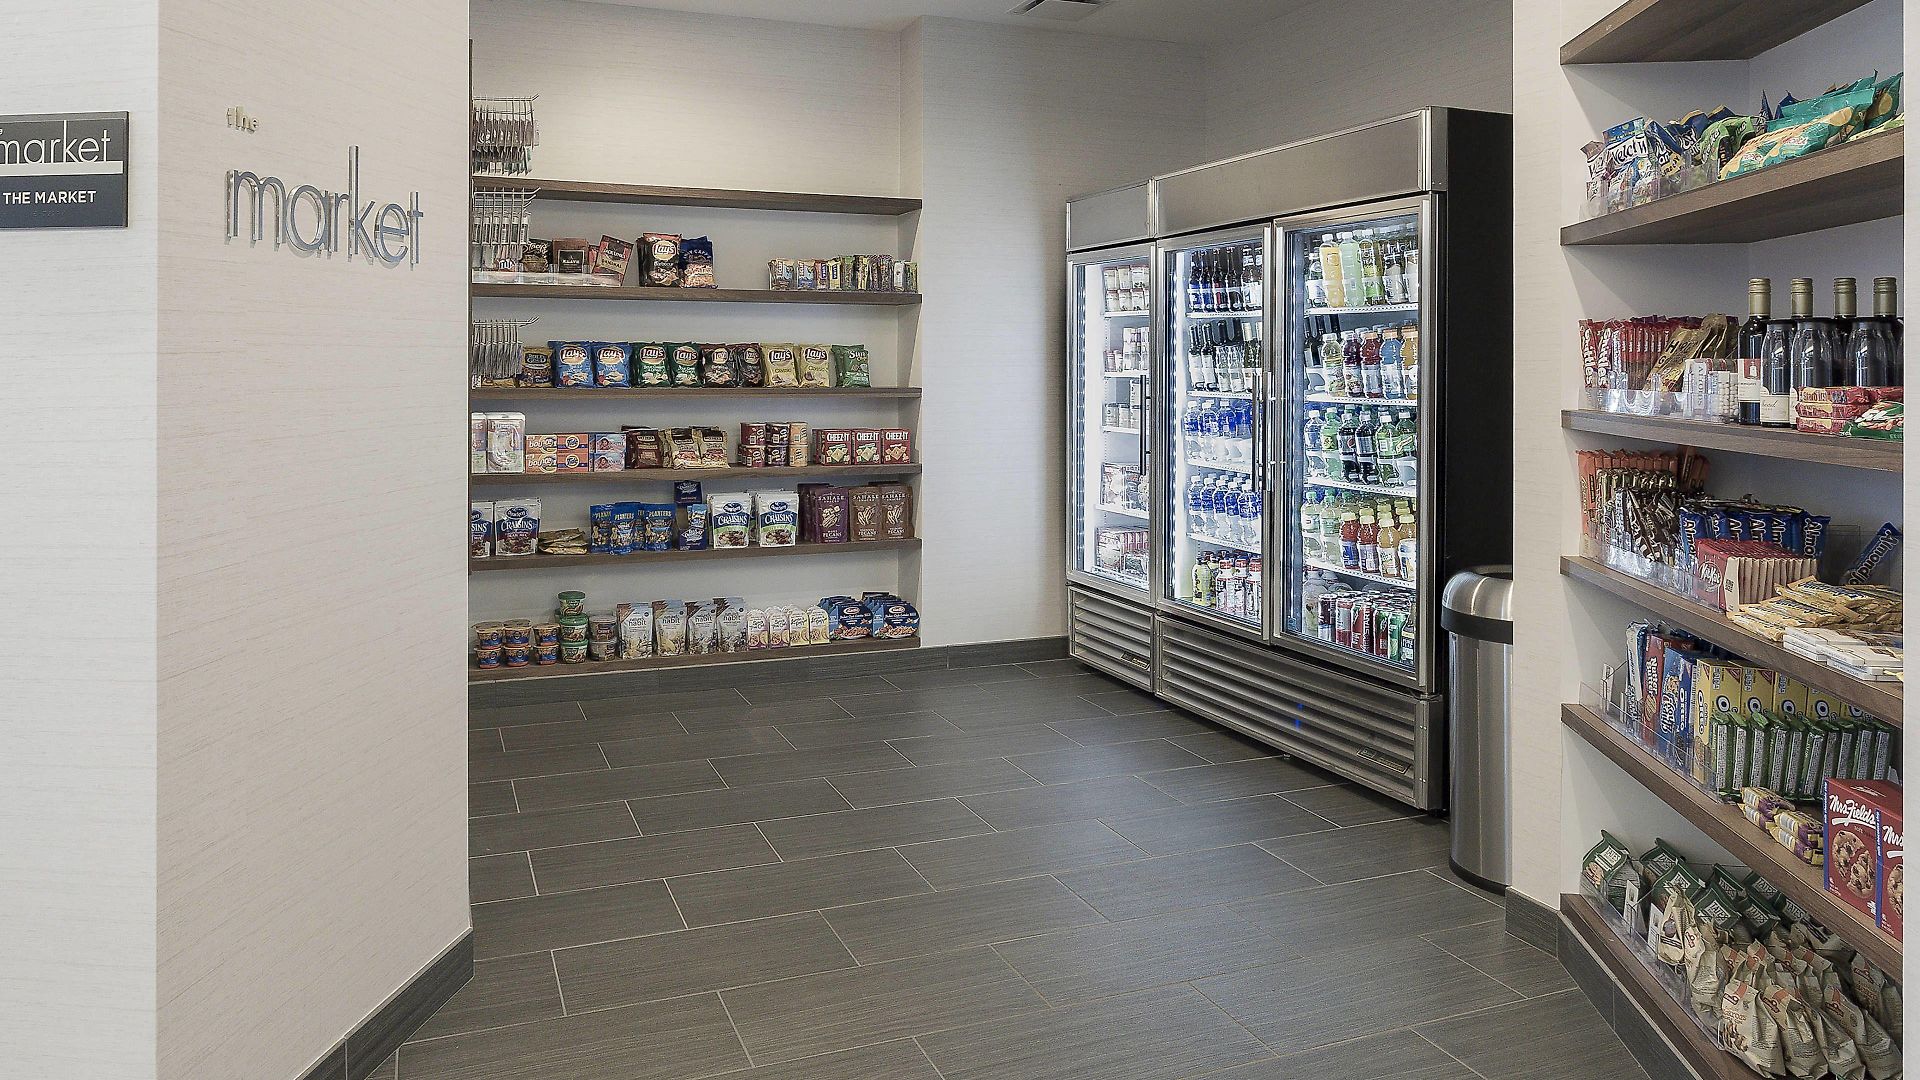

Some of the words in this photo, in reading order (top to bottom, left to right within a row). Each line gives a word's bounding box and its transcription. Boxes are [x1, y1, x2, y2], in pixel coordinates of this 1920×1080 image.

[227, 107, 259, 132] the
[0, 120, 111, 164] market
[3, 192, 31, 205] THE
[34, 190, 97, 204] MARKET
[226, 145, 424, 270] market
[771, 350, 791, 361] Lay's
[806, 348, 826, 359] Lay's
[826, 432, 850, 442] CHEEZ-IT
[856, 432, 880, 441] CHEEZ-IT
[885, 431, 908, 441] CHEEZ-IT
[717, 515, 748, 525] CRAISINS
[765, 514, 793, 524] CRAISINS
[501, 520, 533, 531] CRAISINS
[1650, 657, 1658, 694] Nutter
